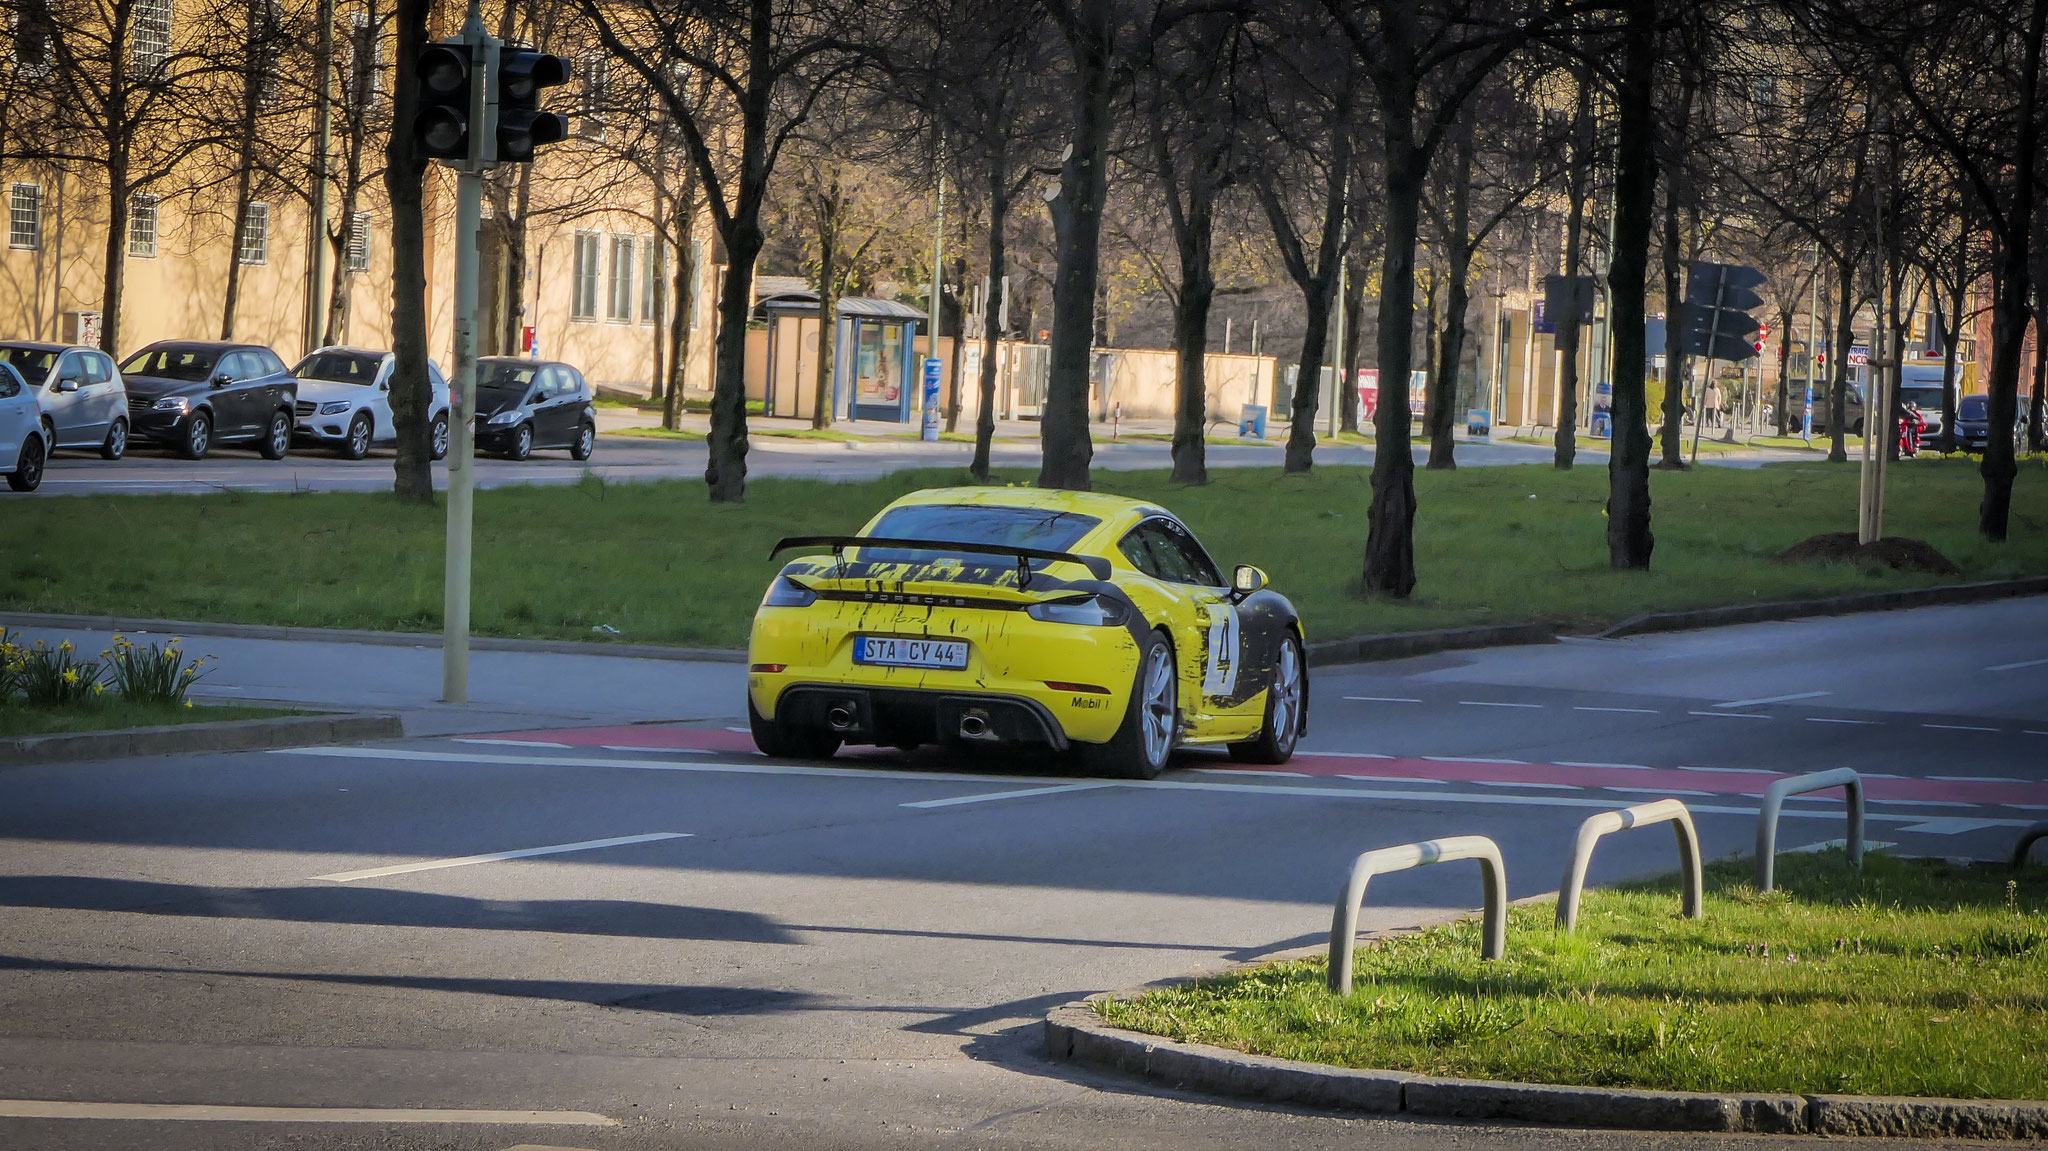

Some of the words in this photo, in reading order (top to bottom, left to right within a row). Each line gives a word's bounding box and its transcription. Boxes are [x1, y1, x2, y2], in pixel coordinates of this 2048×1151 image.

[864, 593, 965, 605] PORSCHE
[865, 640, 896, 659] STA
[909, 642, 931, 661] CY
[934, 643, 954, 662] 44
[1216, 614, 1231, 684] 4
[1071, 697, 1101, 709] Mobil
